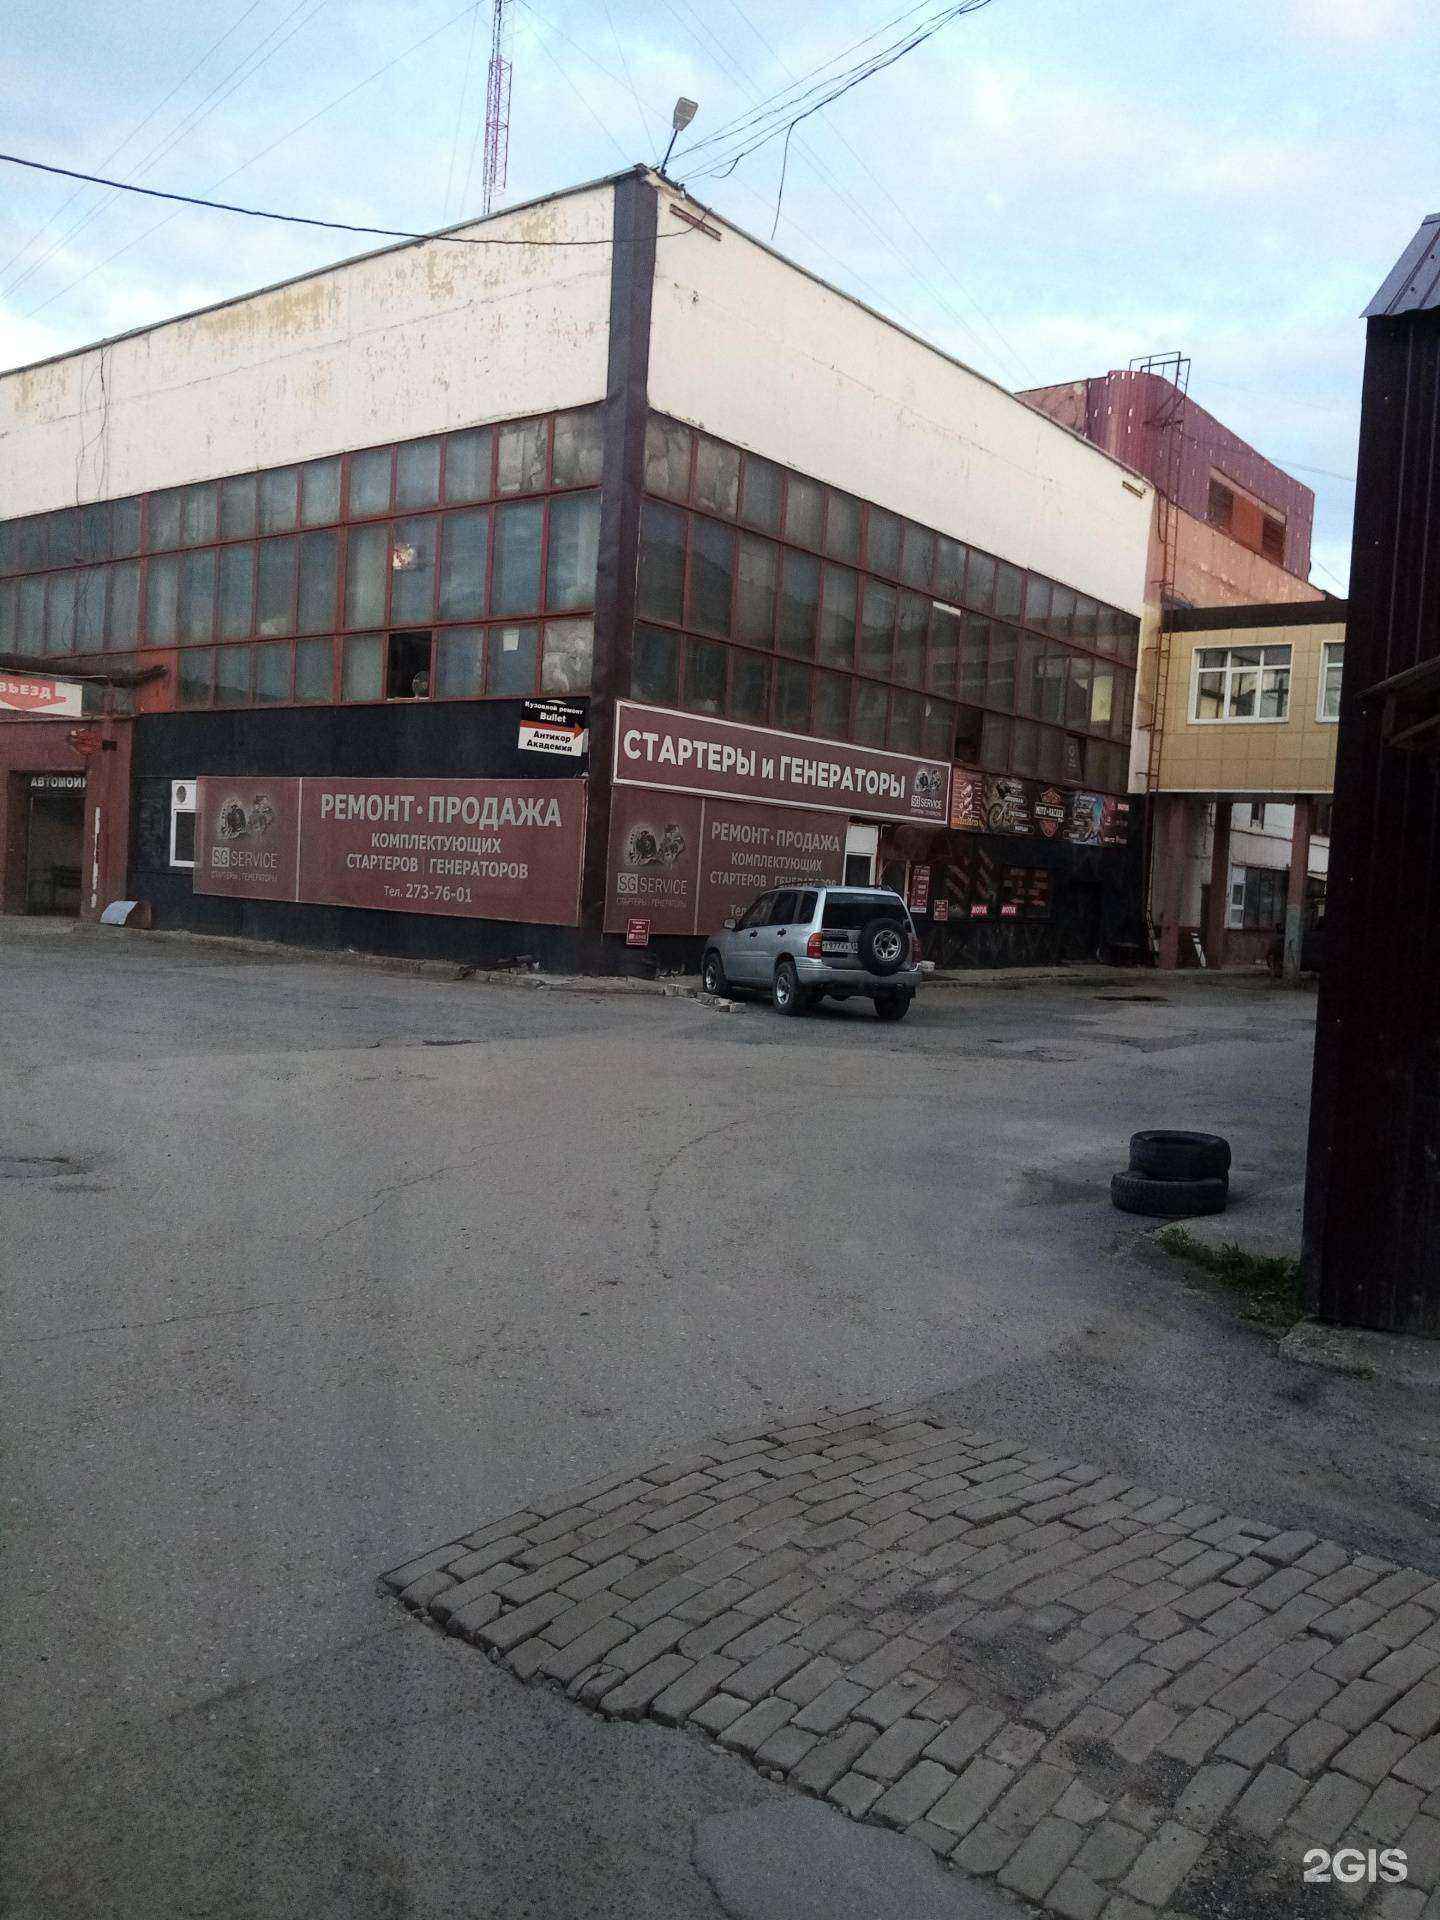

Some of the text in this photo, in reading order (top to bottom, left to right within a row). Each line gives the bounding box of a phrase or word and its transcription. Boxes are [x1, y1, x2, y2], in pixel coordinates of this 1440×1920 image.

[524, 700, 558, 712] Кузовной
[540, 711, 567, 723] Bullet
[526, 739, 573, 752] Академия
[533, 731, 571, 744] Антикор
[623, 729, 756, 777] СТАРТЕРЫ
[780, 755, 906, 799] ГЕНЕРАТОРЫ
[320, 794, 563, 831] РЕМОНТ ПРОДАЖА
[371, 833, 502, 855] КОМПЛЕКТУЮЩИХ
[711, 822, 841, 852] РЕМОНТ ПРОДАЖА
[231, 850, 279, 869] SERVICE
[346, 853, 529, 880] СТАРТЕРОВ ГЕНЕРАТОРОВ
[731, 852, 823, 872] КОМПЛЕКТУЮЩИХ
[617, 873, 688, 895] SG SERVICE
[709, 871, 767, 887] СТАРТЕРОВ
[384, 883, 472, 903] Тел. 273-76-01
